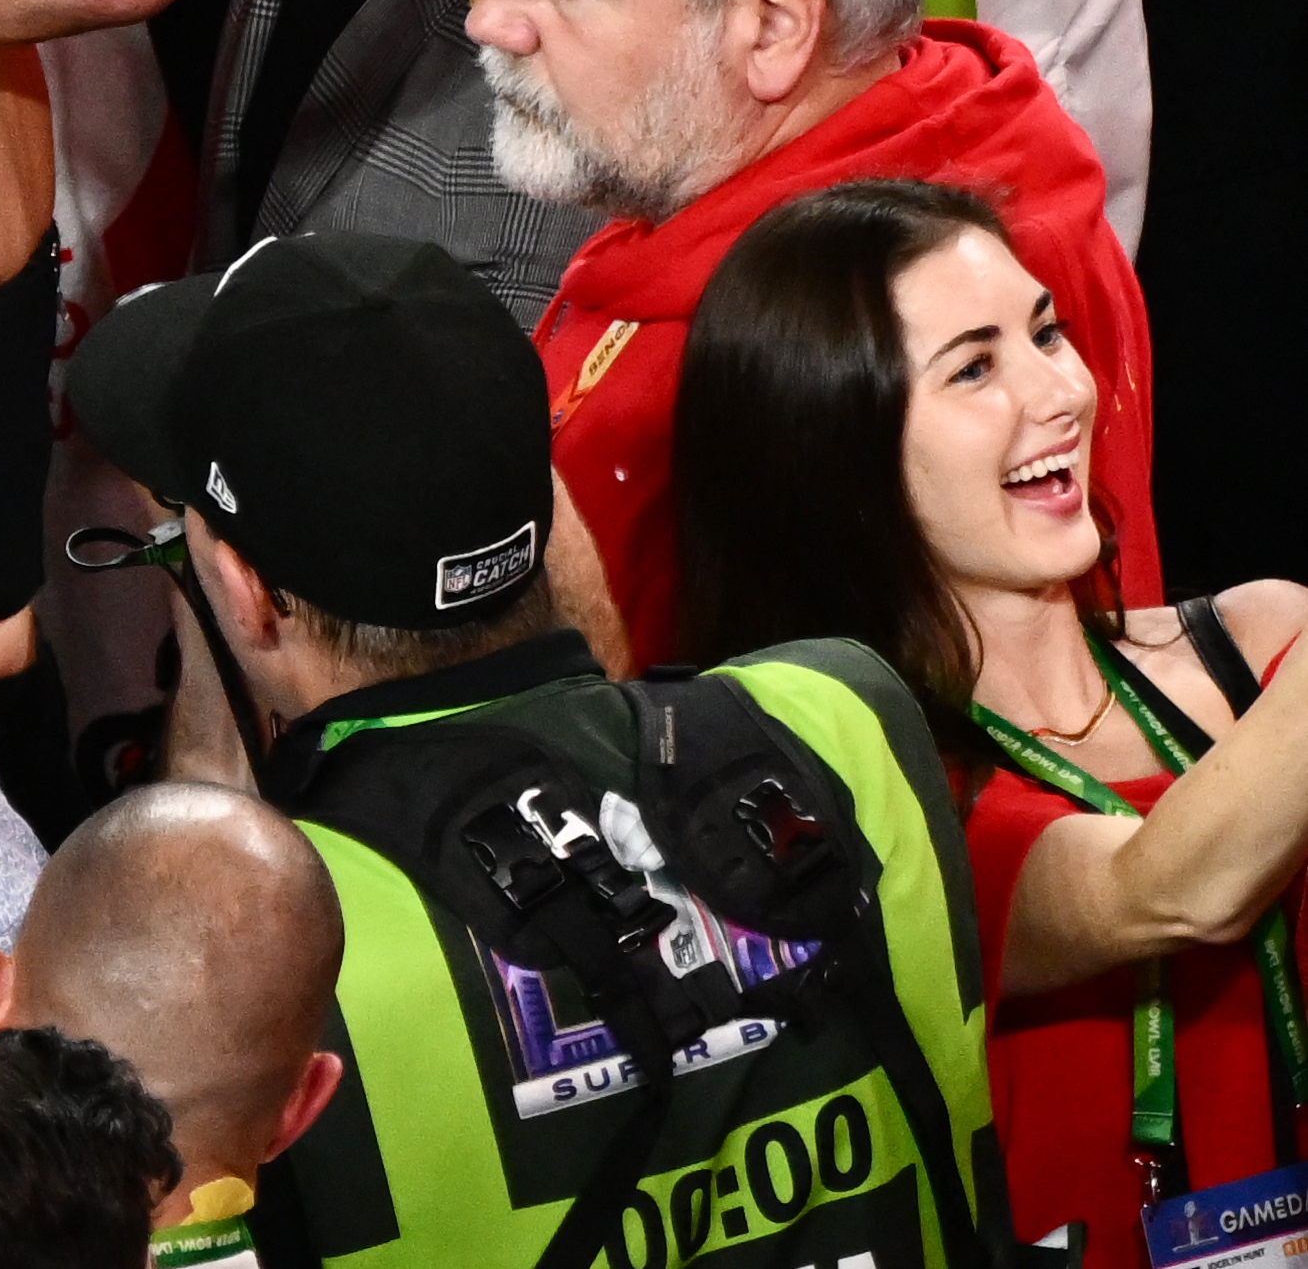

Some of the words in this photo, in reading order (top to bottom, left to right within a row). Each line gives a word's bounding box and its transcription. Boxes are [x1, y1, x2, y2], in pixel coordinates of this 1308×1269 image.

[473, 544, 530, 587] CATCH
[476, 544, 518, 570] CRUCIAL
[446, 575, 471, 591] NFL
[1021, 748, 1056, 772] BOWL
[552, 1040, 712, 1102] SUPR
[1219, 1192, 1308, 1234] GAMED
